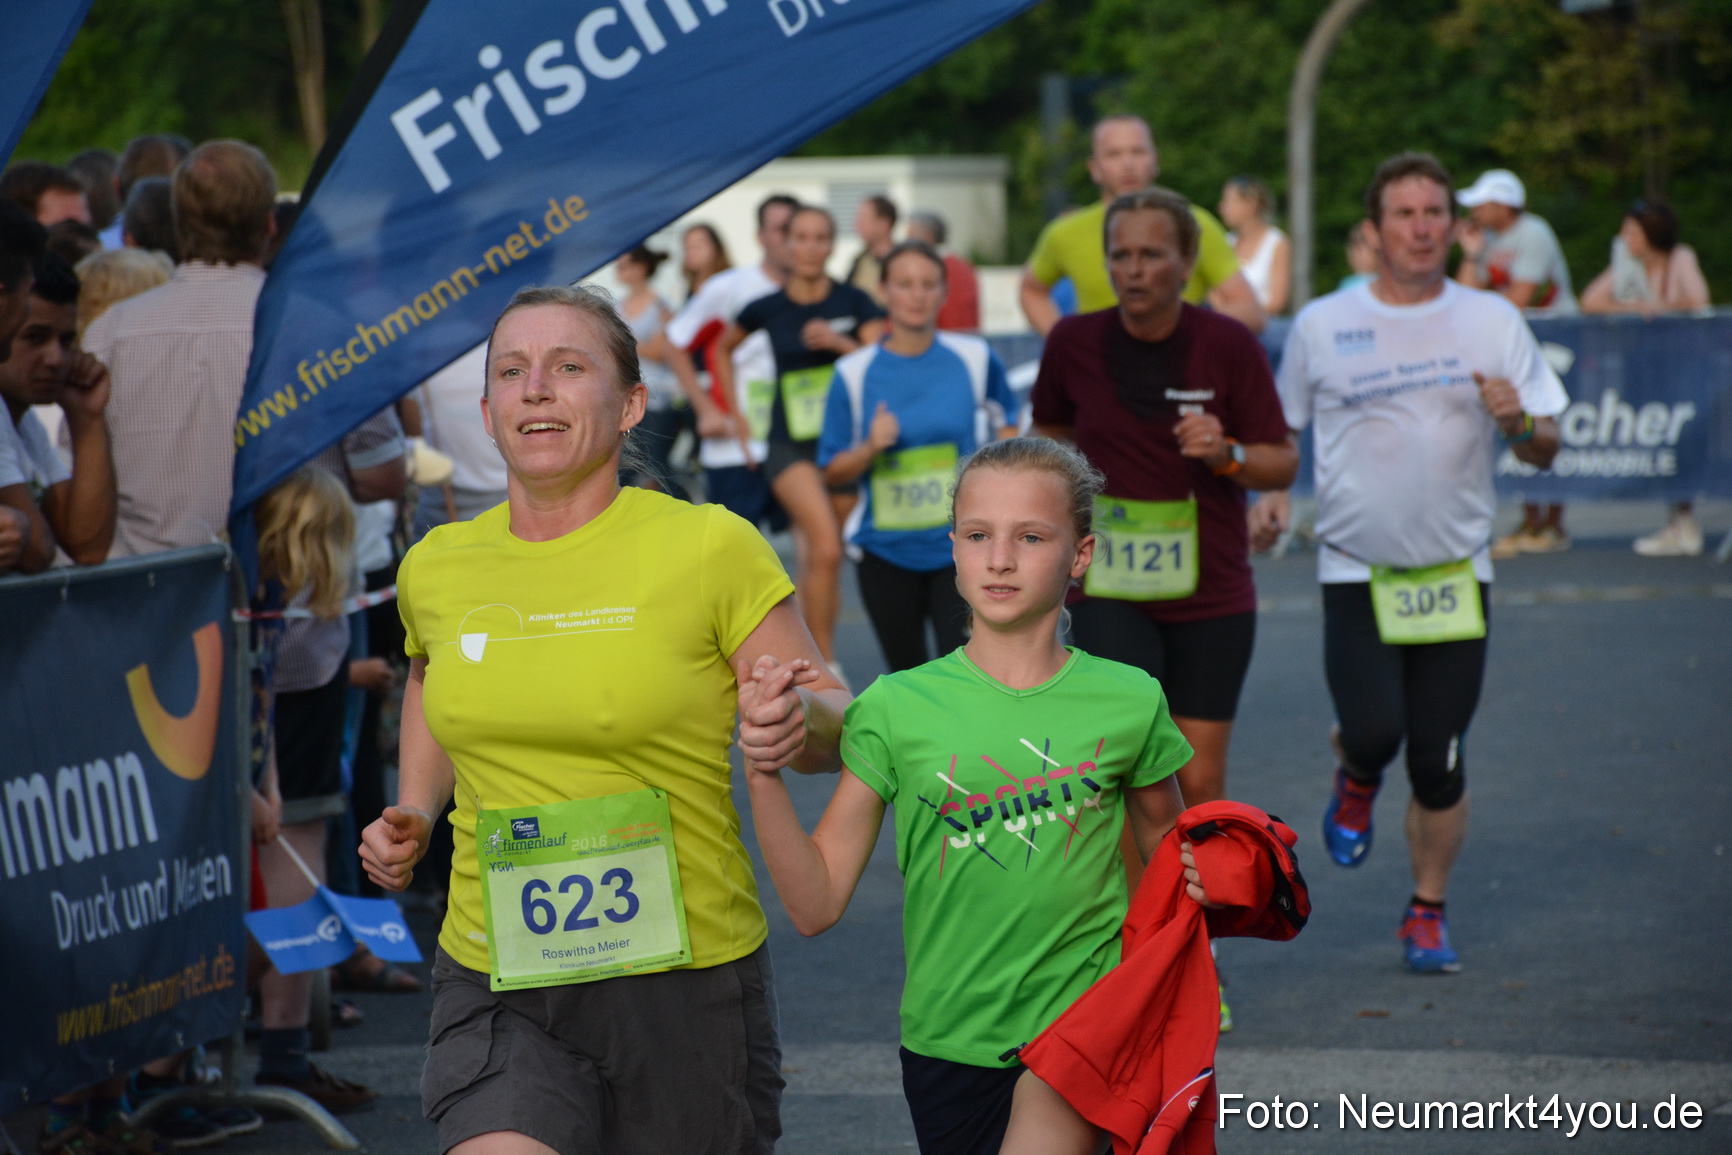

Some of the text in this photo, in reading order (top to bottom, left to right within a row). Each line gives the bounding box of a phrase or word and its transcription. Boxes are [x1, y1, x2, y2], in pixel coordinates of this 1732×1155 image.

[390, 0, 730, 193] Frisch
[1560, 388, 1697, 447] cher
[1498, 448, 1678, 478] AOMOBILE
[528, 606, 637, 623] Kliniken des Landkreises
[1395, 584, 1458, 618] 305
[555, 618, 600, 629] Neumarkt
[940, 760, 1102, 849] SPORTS
[503, 832, 567, 851] firmenlauf
[571, 835, 608, 851] 2016
[51, 875, 121, 950] Druck
[121, 859, 169, 930] und
[521, 867, 640, 935] 623
[542, 938, 631, 961] Roswitha Meier
[559, 955, 617, 970] Klinikum Neumarkt
